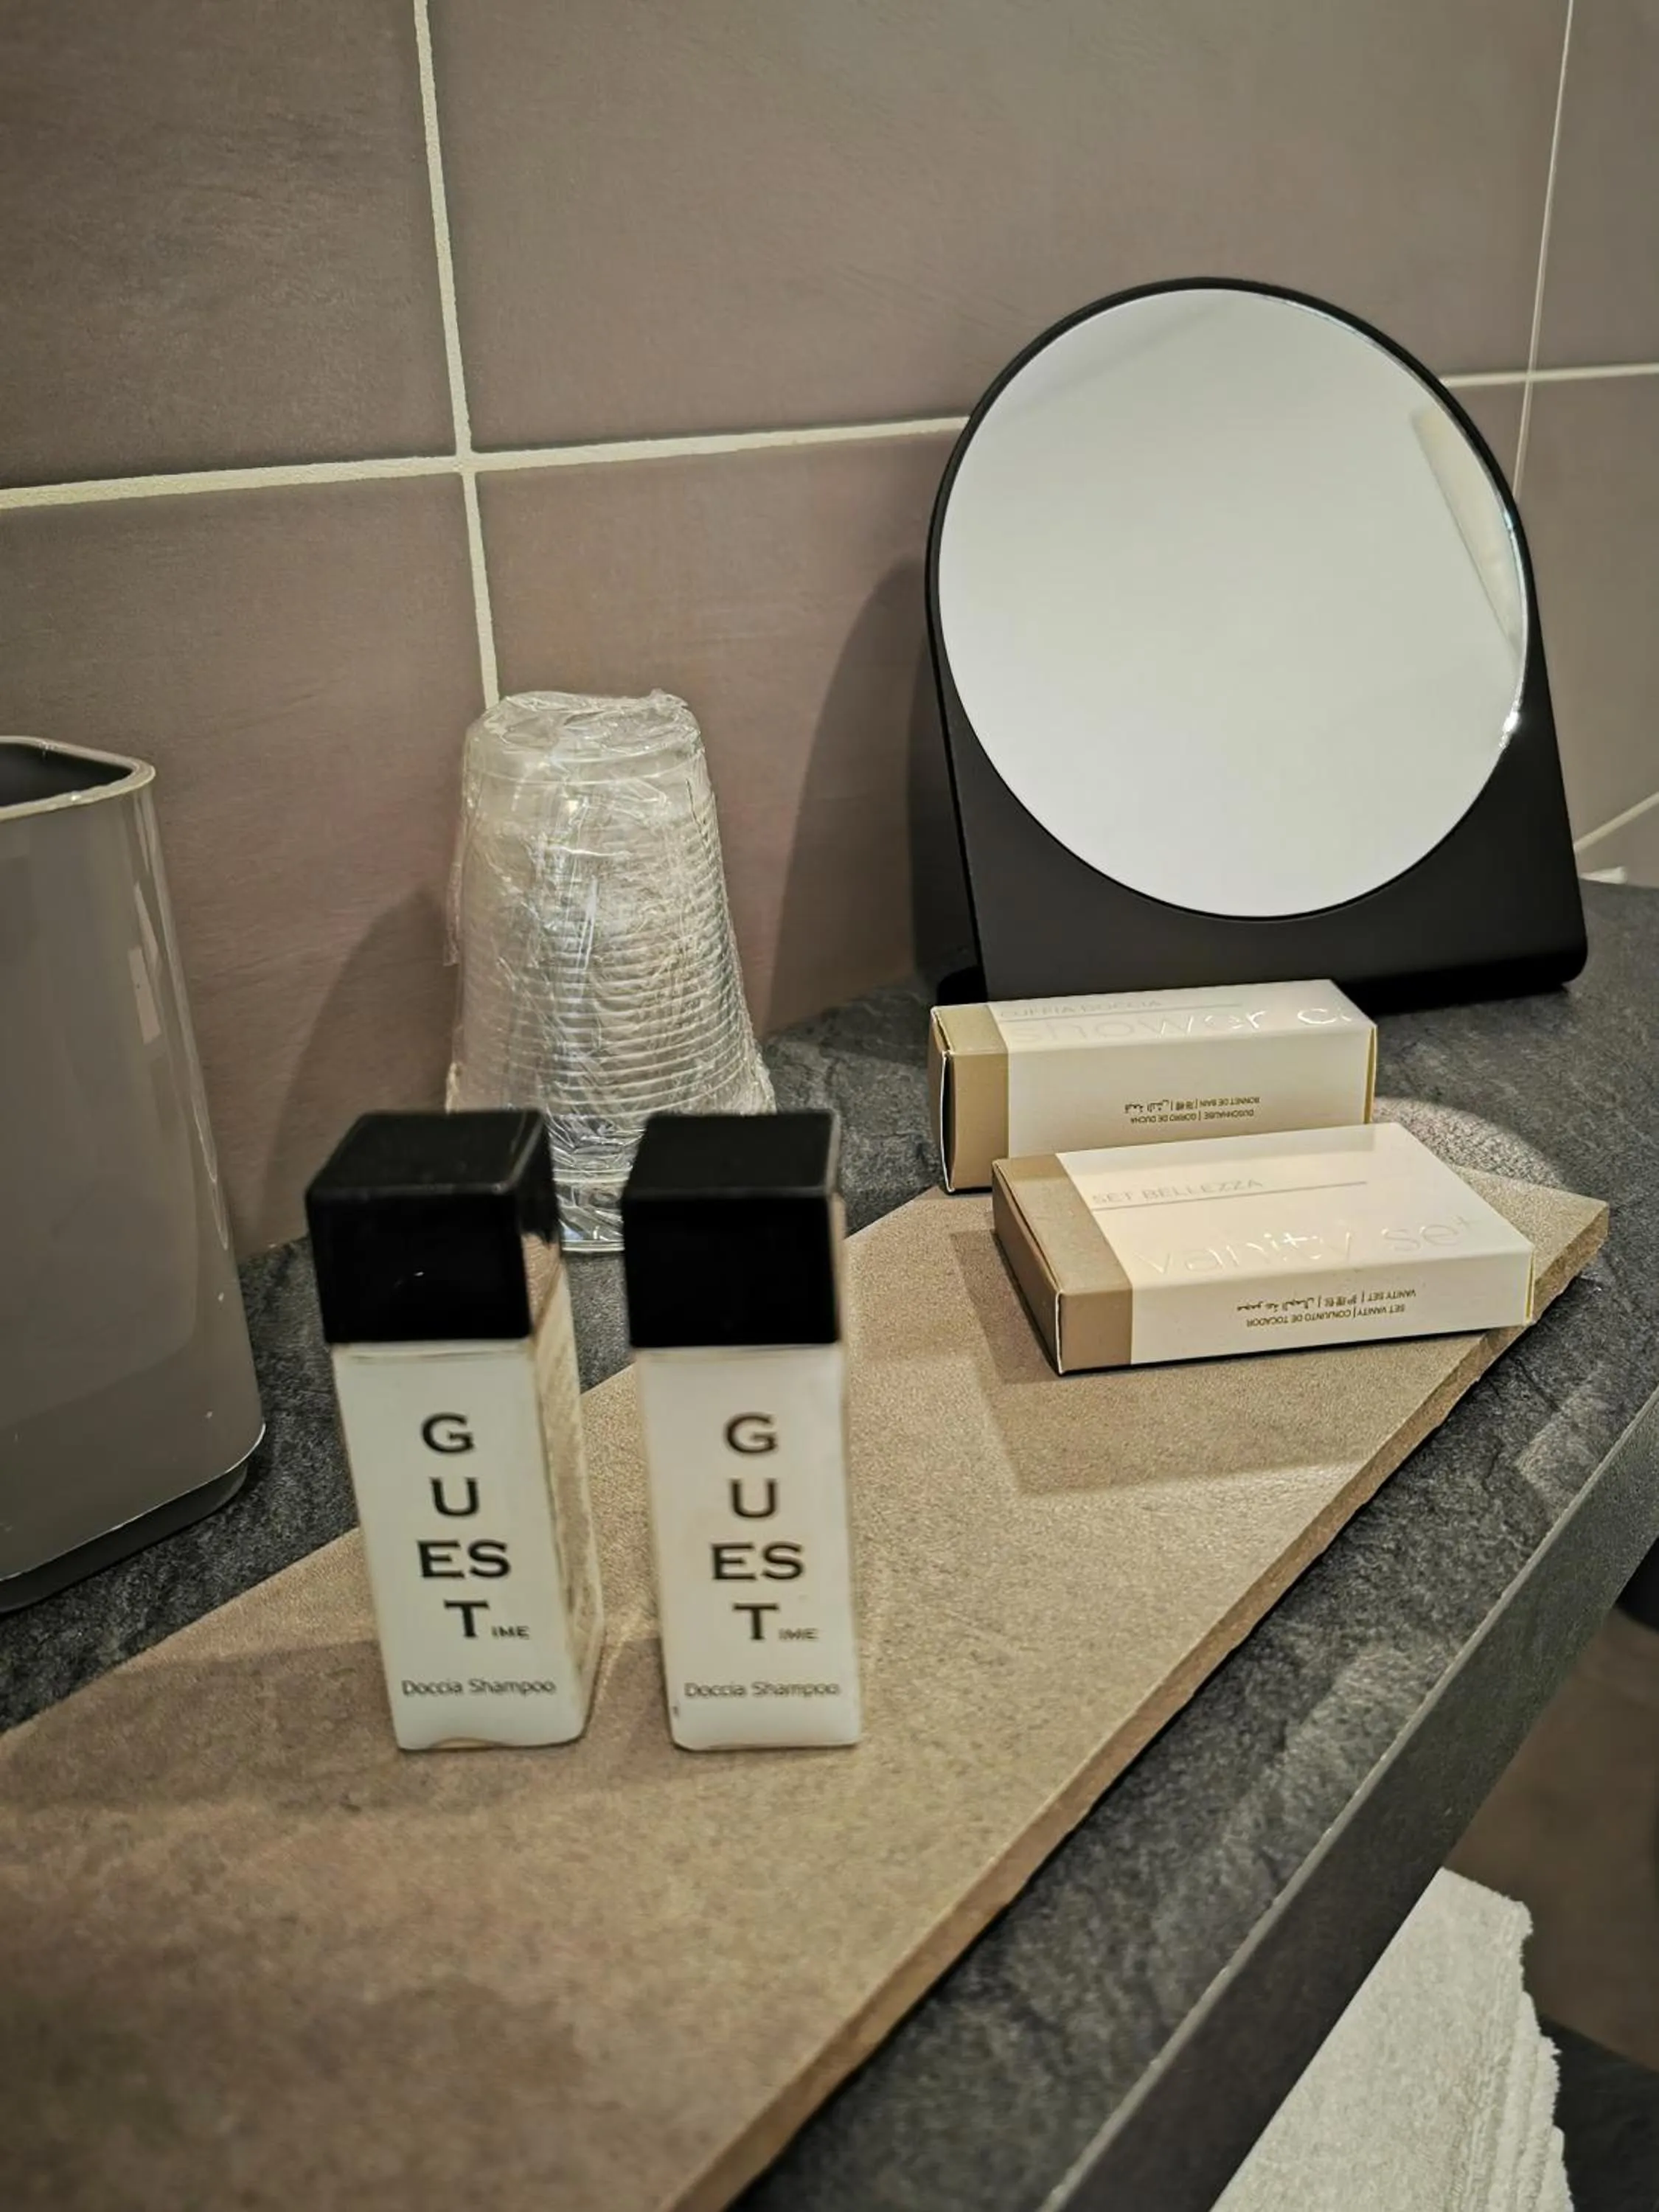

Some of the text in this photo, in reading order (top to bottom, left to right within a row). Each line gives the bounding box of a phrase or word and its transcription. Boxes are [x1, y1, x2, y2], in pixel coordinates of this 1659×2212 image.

[1199, 1098, 1217, 1107] BAIN
[1218, 1098, 1228, 1107] DE
[1130, 1116, 1157, 1124] DUCHA
[1157, 1115, 1169, 1123] DE
[1092, 1178, 1265, 1205] SET BELLEZZA
[1134, 1214, 1481, 1275] vanity set
[1367, 1289, 1416, 1302] VANITY SET
[1357, 1304, 1405, 1317] SET VANITY
[1246, 1310, 1352, 1327] CONJUNTO DE TOCADOR
[402, 1677, 557, 1696] Doccia Shampoo
[684, 1680, 841, 1698] Doccia Shampoo
